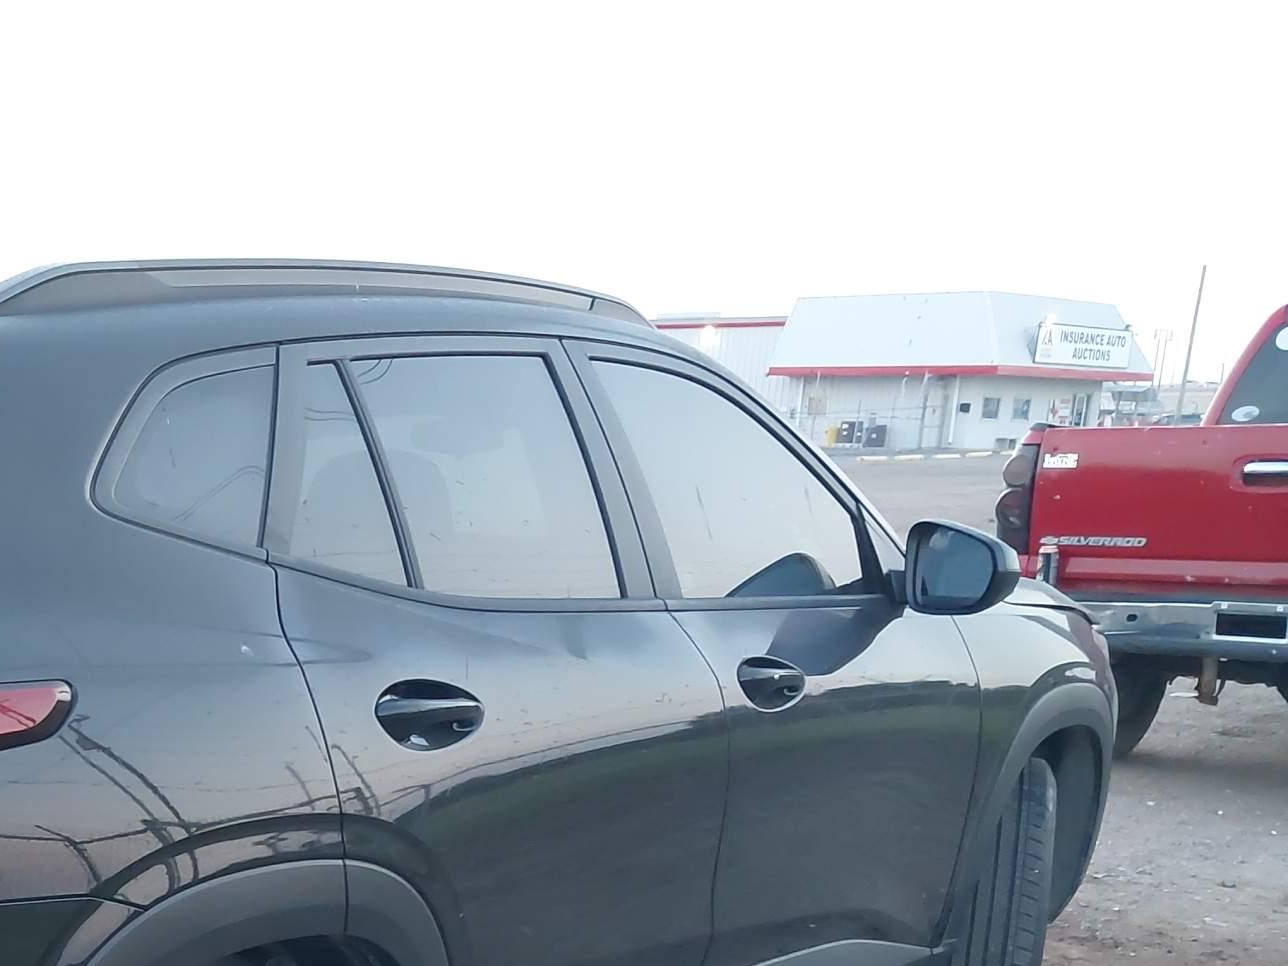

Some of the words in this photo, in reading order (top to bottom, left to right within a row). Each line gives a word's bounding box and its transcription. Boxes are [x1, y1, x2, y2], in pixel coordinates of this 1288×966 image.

[1060, 329, 1105, 346] INSURANCE
[1106, 335, 1127, 348] AUTO
[1072, 347, 1111, 361] AUCTIONS
[1058, 536, 1147, 547] SILVERADO
